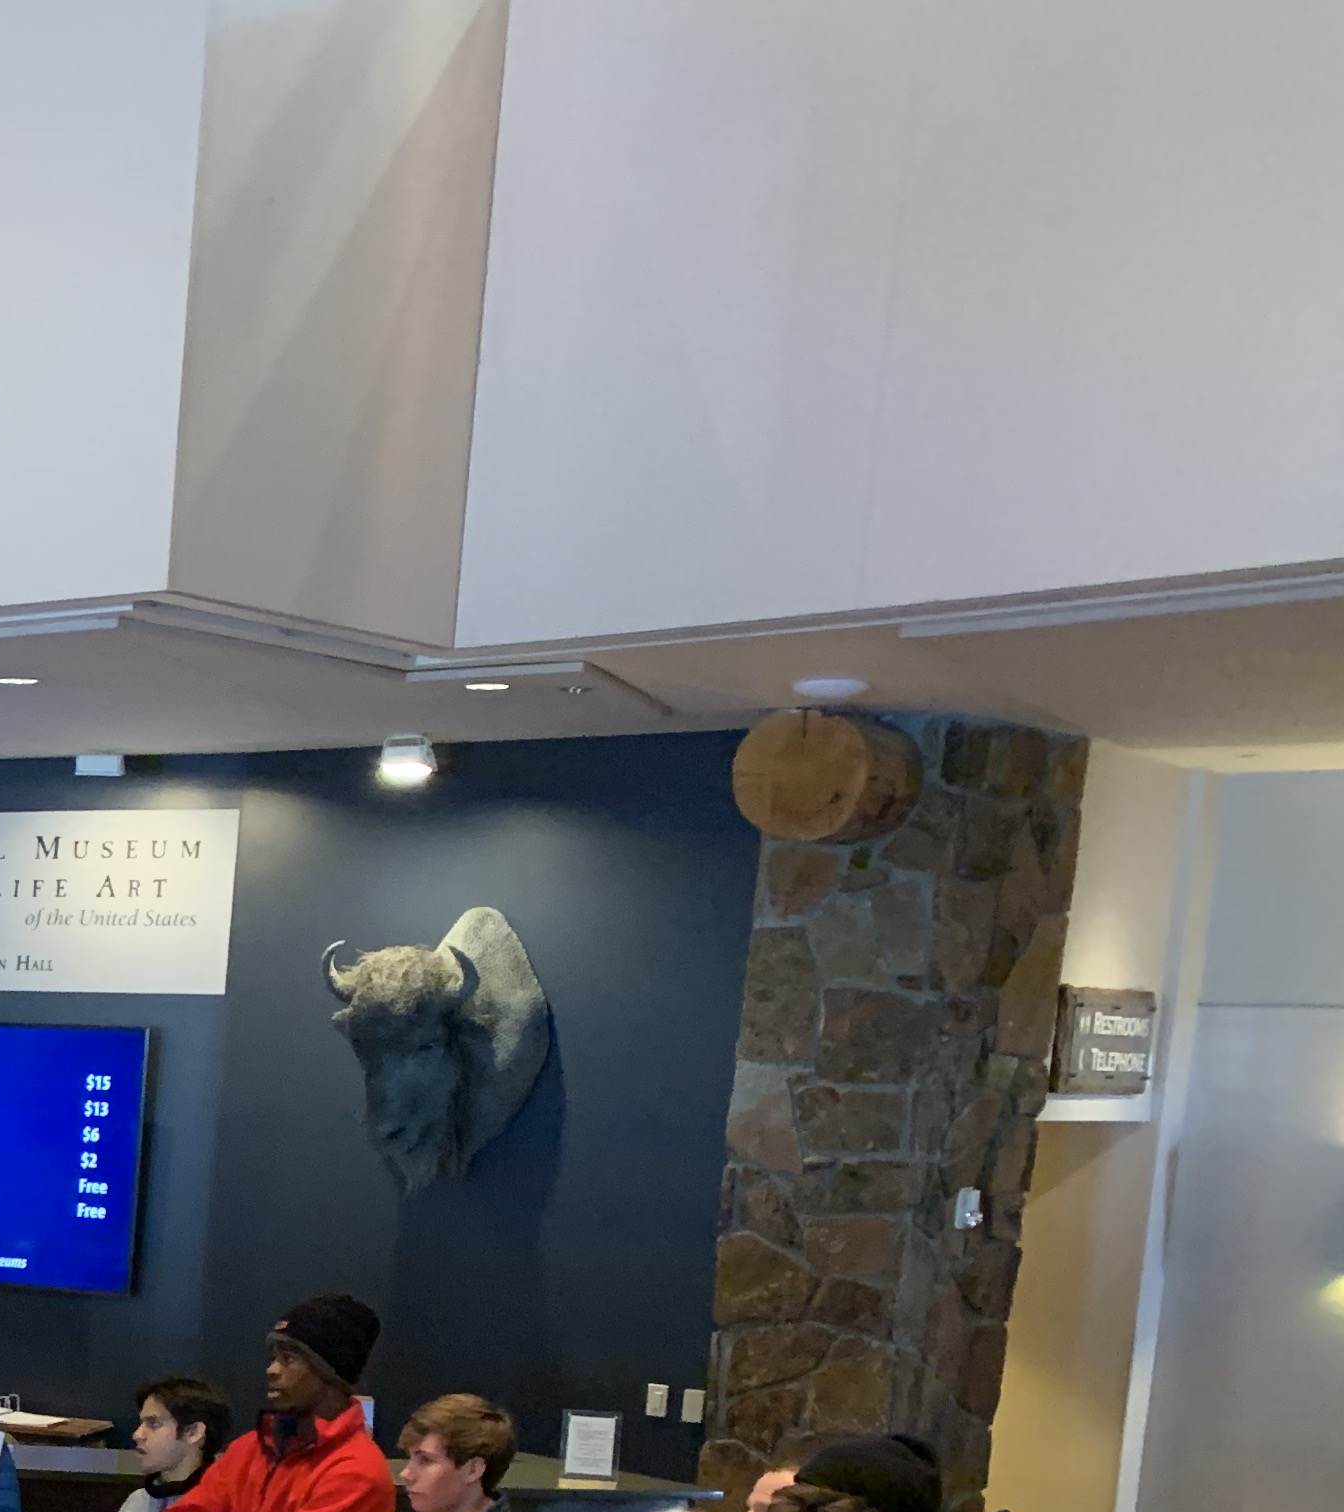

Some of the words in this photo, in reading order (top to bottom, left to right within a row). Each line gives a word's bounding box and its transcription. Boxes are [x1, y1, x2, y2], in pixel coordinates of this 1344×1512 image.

[34, 834, 202, 861] MUSEUM
[96, 873, 169, 898] ART
[24, 908, 44, 930] of
[45, 907, 75, 927] the
[79, 907, 139, 927] United
[143, 908, 197, 927] States
[15, 954, 54, 972] HALL
[86, 1073, 111, 1092] $15
[84, 1100, 109, 1117] $13
[82, 1125, 100, 1143] $6
[80, 1151, 98, 1169] $2
[78, 1178, 108, 1195] Free
[76, 1202, 107, 1220] Free
